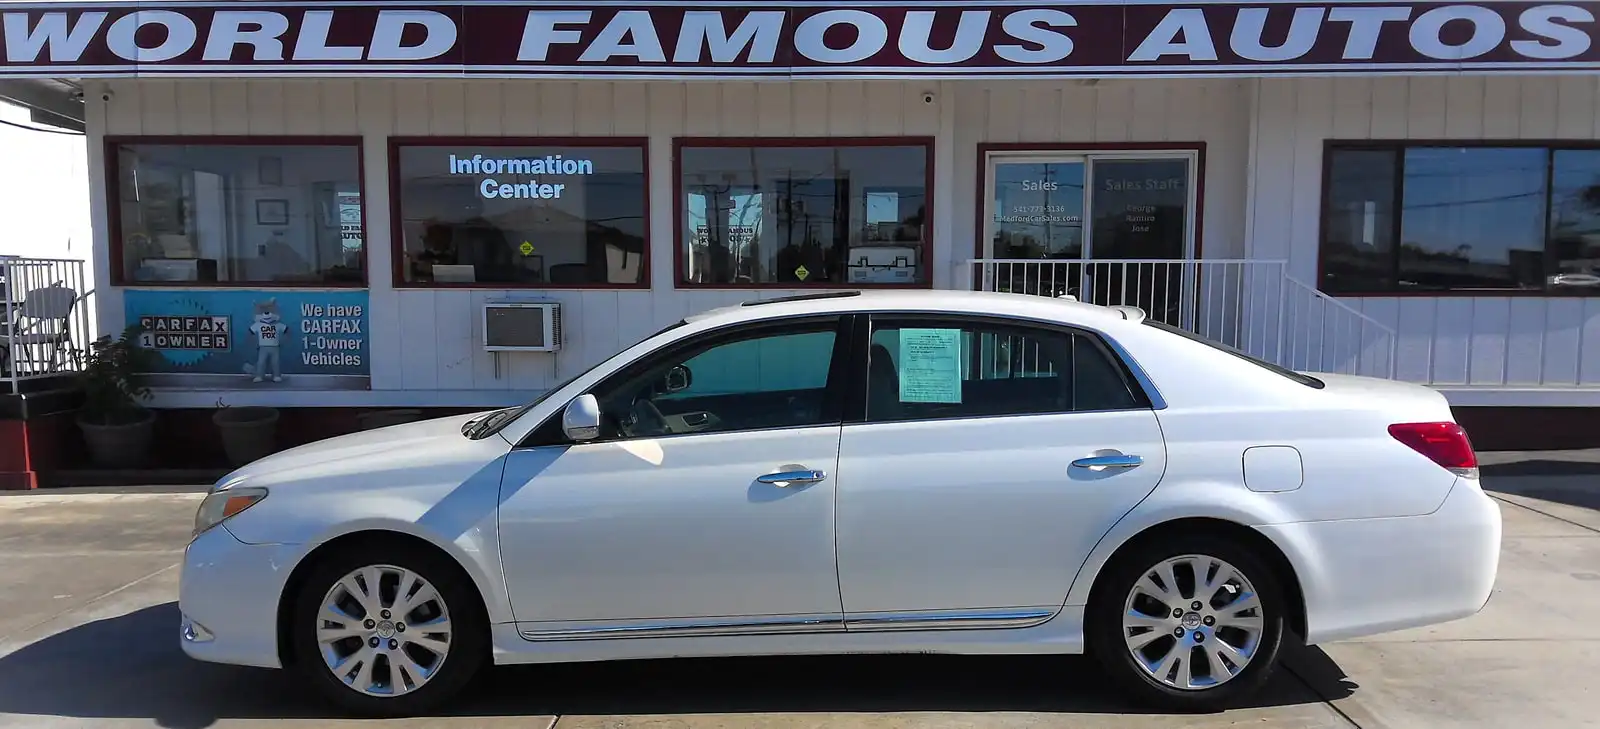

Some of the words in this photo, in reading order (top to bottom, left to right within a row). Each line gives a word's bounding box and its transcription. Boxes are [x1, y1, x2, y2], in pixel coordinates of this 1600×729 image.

[2, 9, 458, 63] WORLD
[516, 8, 1078, 64] FAMOUS
[1126, 5, 1595, 61] AUTOS
[449, 154, 593, 175] Information
[480, 178, 565, 199] Center
[1022, 179, 1058, 191] Sales
[1105, 178, 1142, 191] Sales
[1145, 178, 1180, 191] Staff
[300, 303, 322, 317] We
[327, 302, 362, 317] have
[141, 318, 225, 332] CARFAX
[260, 325, 276, 333] CAR
[301, 319, 362, 334] CARFAX
[143, 335, 151, 346] 1
[157, 336, 226, 347] OWNER
[301, 335, 363, 350] 1-Owner
[301, 351, 361, 365] Vehicles
